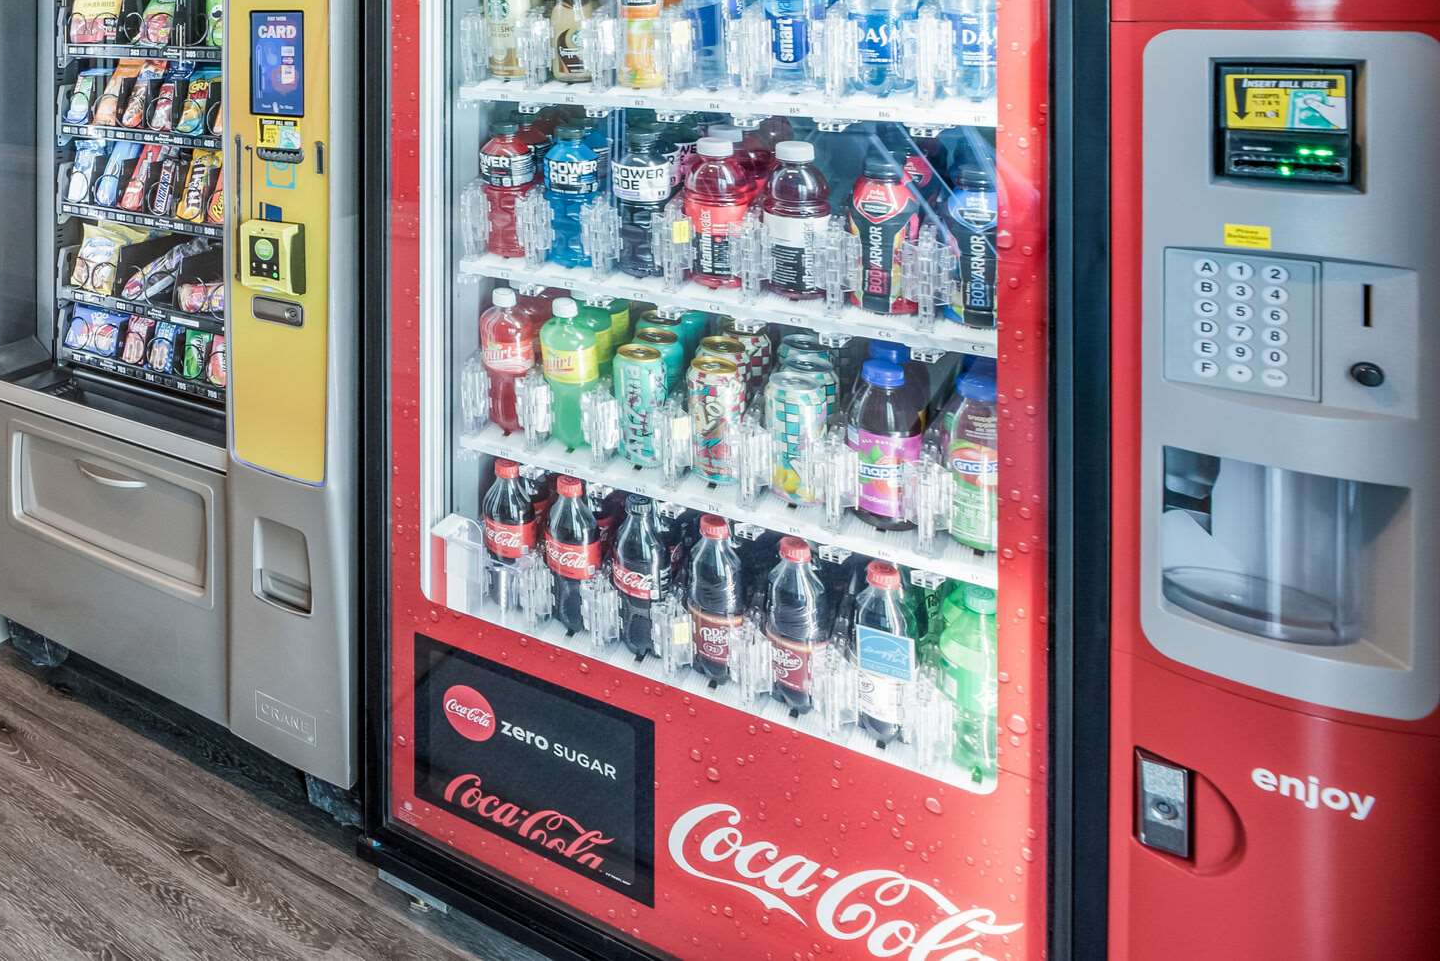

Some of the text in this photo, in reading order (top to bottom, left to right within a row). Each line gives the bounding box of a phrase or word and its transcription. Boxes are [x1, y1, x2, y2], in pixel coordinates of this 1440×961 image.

[258, 25, 297, 38] CARD
[779, 17, 794, 62] smart
[1242, 78, 1278, 88] INSERT
[1278, 80, 1300, 88] BILL
[549, 159, 598, 174] POWER
[550, 173, 578, 185] ADE
[155, 173, 171, 210] SNICKERS
[869, 226, 883, 294] BODYARMOR
[971, 235, 986, 307] BODYARMOR
[1200, 262, 1213, 273] A
[1237, 266, 1244, 276] 1
[1270, 269, 1281, 280] 2
[1200, 281, 1213, 293] B
[1236, 286, 1246, 296] 3
[1270, 289, 1280, 300] 4
[1200, 301, 1213, 313] C
[1235, 306, 1246, 317] 5
[1270, 310, 1281, 321] 6
[1200, 322, 1213, 333] D
[1235, 326, 1246, 336] 7
[1270, 331, 1280, 342] 8
[1201, 342, 1212, 353] E
[1235, 347, 1246, 358] 9
[1270, 351, 1280, 362] 0
[1201, 362, 1212, 374] F
[446, 698, 493, 727] Coca-Cola
[261, 703, 311, 735] CRANE
[500, 720, 617, 780] zero SUGAR
[1251, 767, 1376, 821] enjoy
[444, 773, 615, 870] Coca-Cola
[668, 802, 1024, 961] Coca-Cola
